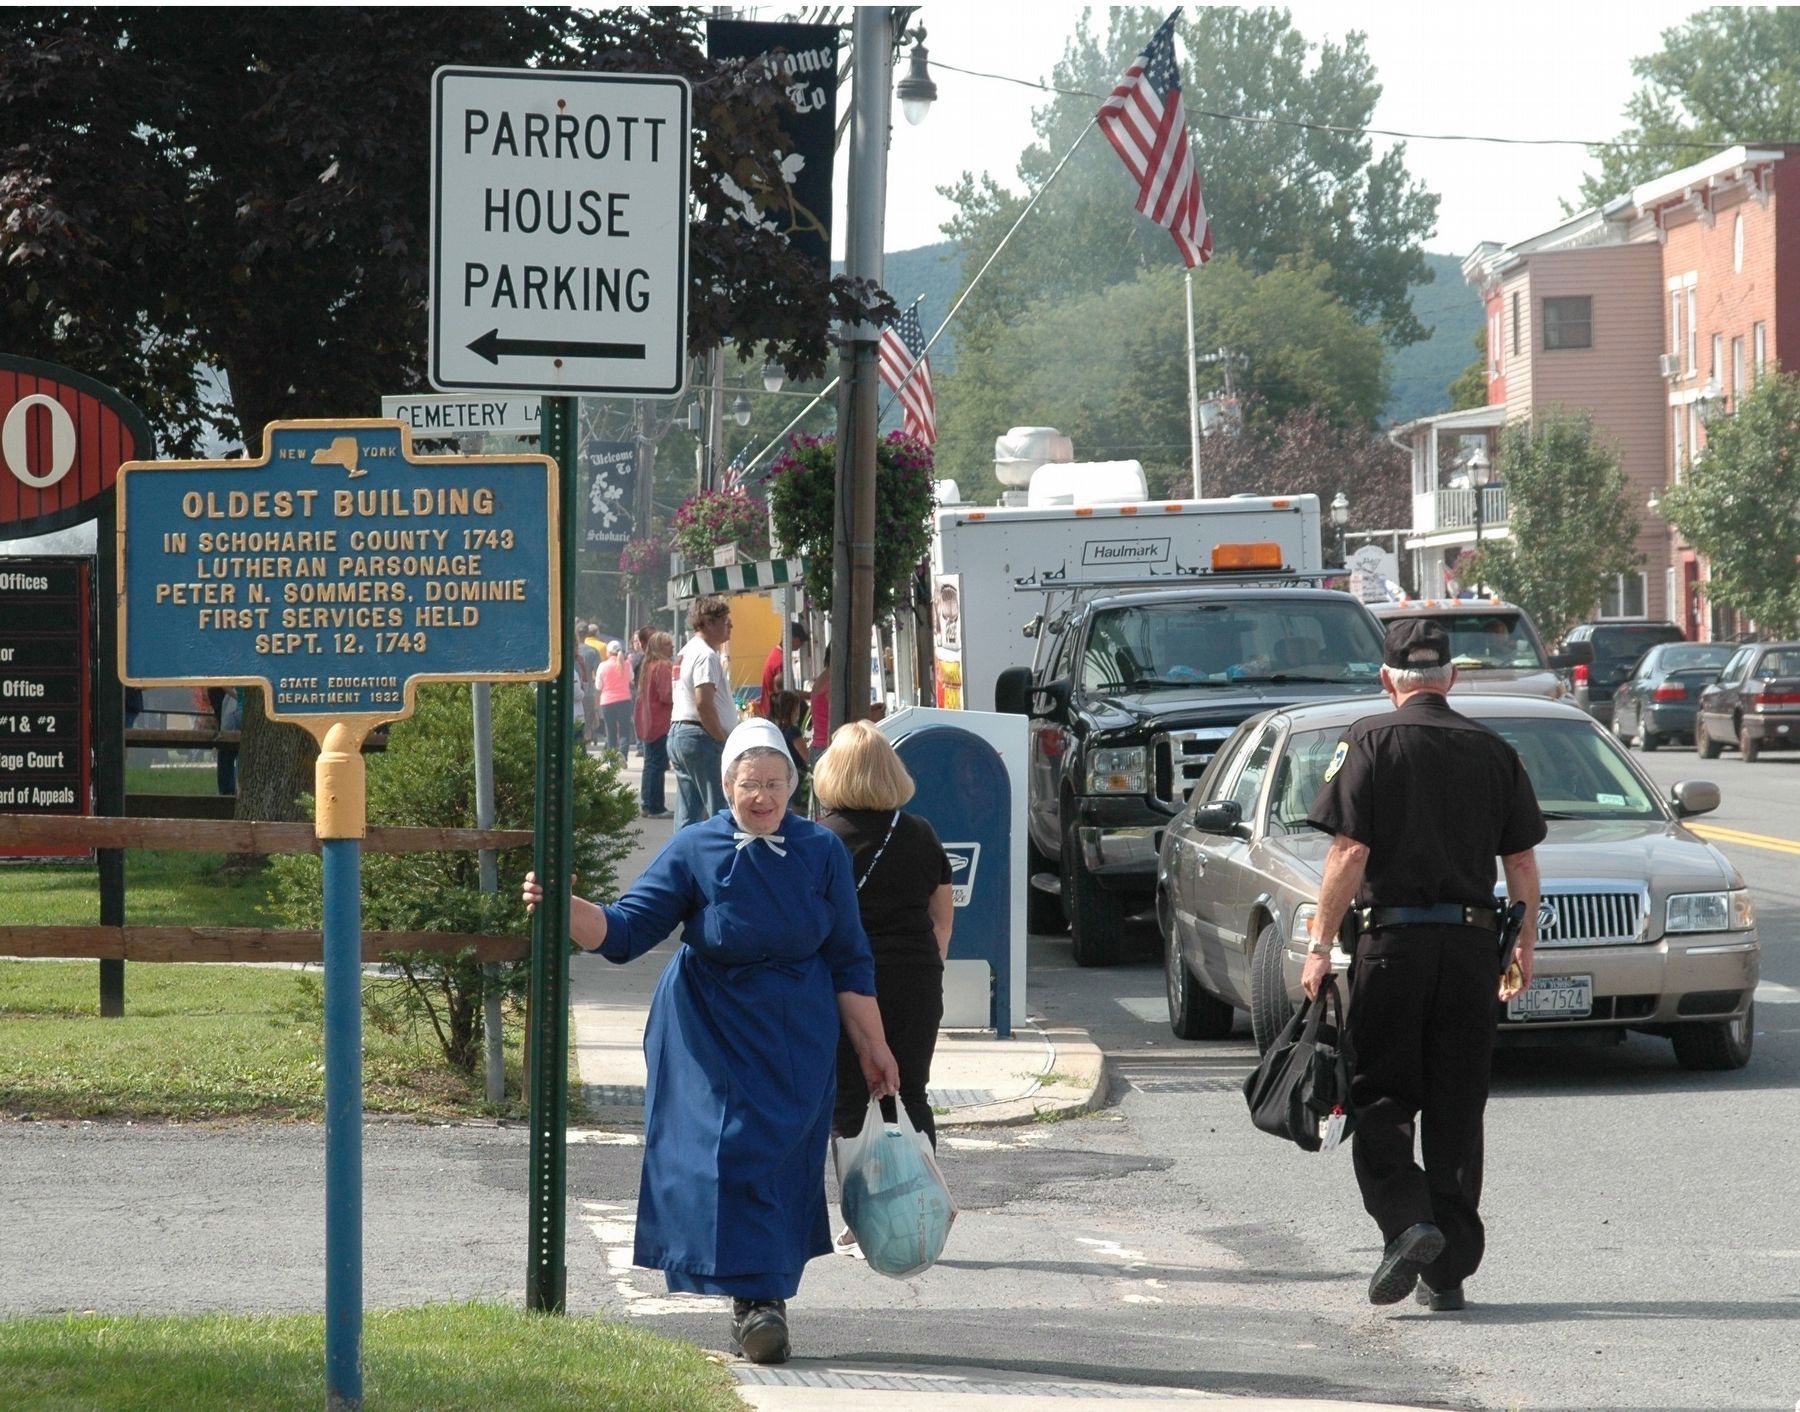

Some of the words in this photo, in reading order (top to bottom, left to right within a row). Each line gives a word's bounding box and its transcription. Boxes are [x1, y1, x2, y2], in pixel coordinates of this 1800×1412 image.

[785, 80, 827, 113] To
[464, 108, 667, 163] PARROTT
[484, 187, 631, 238] HOUSE
[464, 261, 651, 314] PARKING
[396, 402, 508, 428] CEMETERY
[279, 448, 306, 460] NEW
[362, 447, 397, 458] YORK
[590, 450, 633, 466] Welcome
[615, 462, 631, 475] To
[182, 490, 318, 519] OLDEST
[334, 487, 495, 517] BUILDING
[163, 532, 187, 553] IN
[199, 530, 337, 553] SCHOHARIE
[350, 528, 449, 551] COUNTY
[463, 528, 514, 550] 1743
[1094, 543, 1159, 559] Haulmark
[197, 557, 327, 579] LUTHERAN
[338, 555, 482, 577] PARSONAGE
[0, 573, 48, 590] Offices
[156, 583, 236, 605] PETER
[248, 582, 272, 604] N.
[283, 581, 413, 603] SOMMERS,
[425, 579, 528, 602] DOMINIE
[199, 608, 270, 630] FIRST
[281, 607, 404, 629] SERVICES
[415, 606, 480, 628] HELD
[255, 632, 323, 654] SEPT.
[334, 632, 365, 654] 12,
[375, 631, 427, 653] 1743
[3, 680, 44, 697] Office
[279, 677, 318, 689] STATE
[327, 676, 398, 688] EDUCATION
[278, 692, 361, 704] DEPARTMENT
[369, 691, 399, 703] 1932
[19, 716, 31, 732] &
[27, 751, 65, 768] Court
[17, 787, 29, 804] of
[32, 787, 74, 806] Appeals
